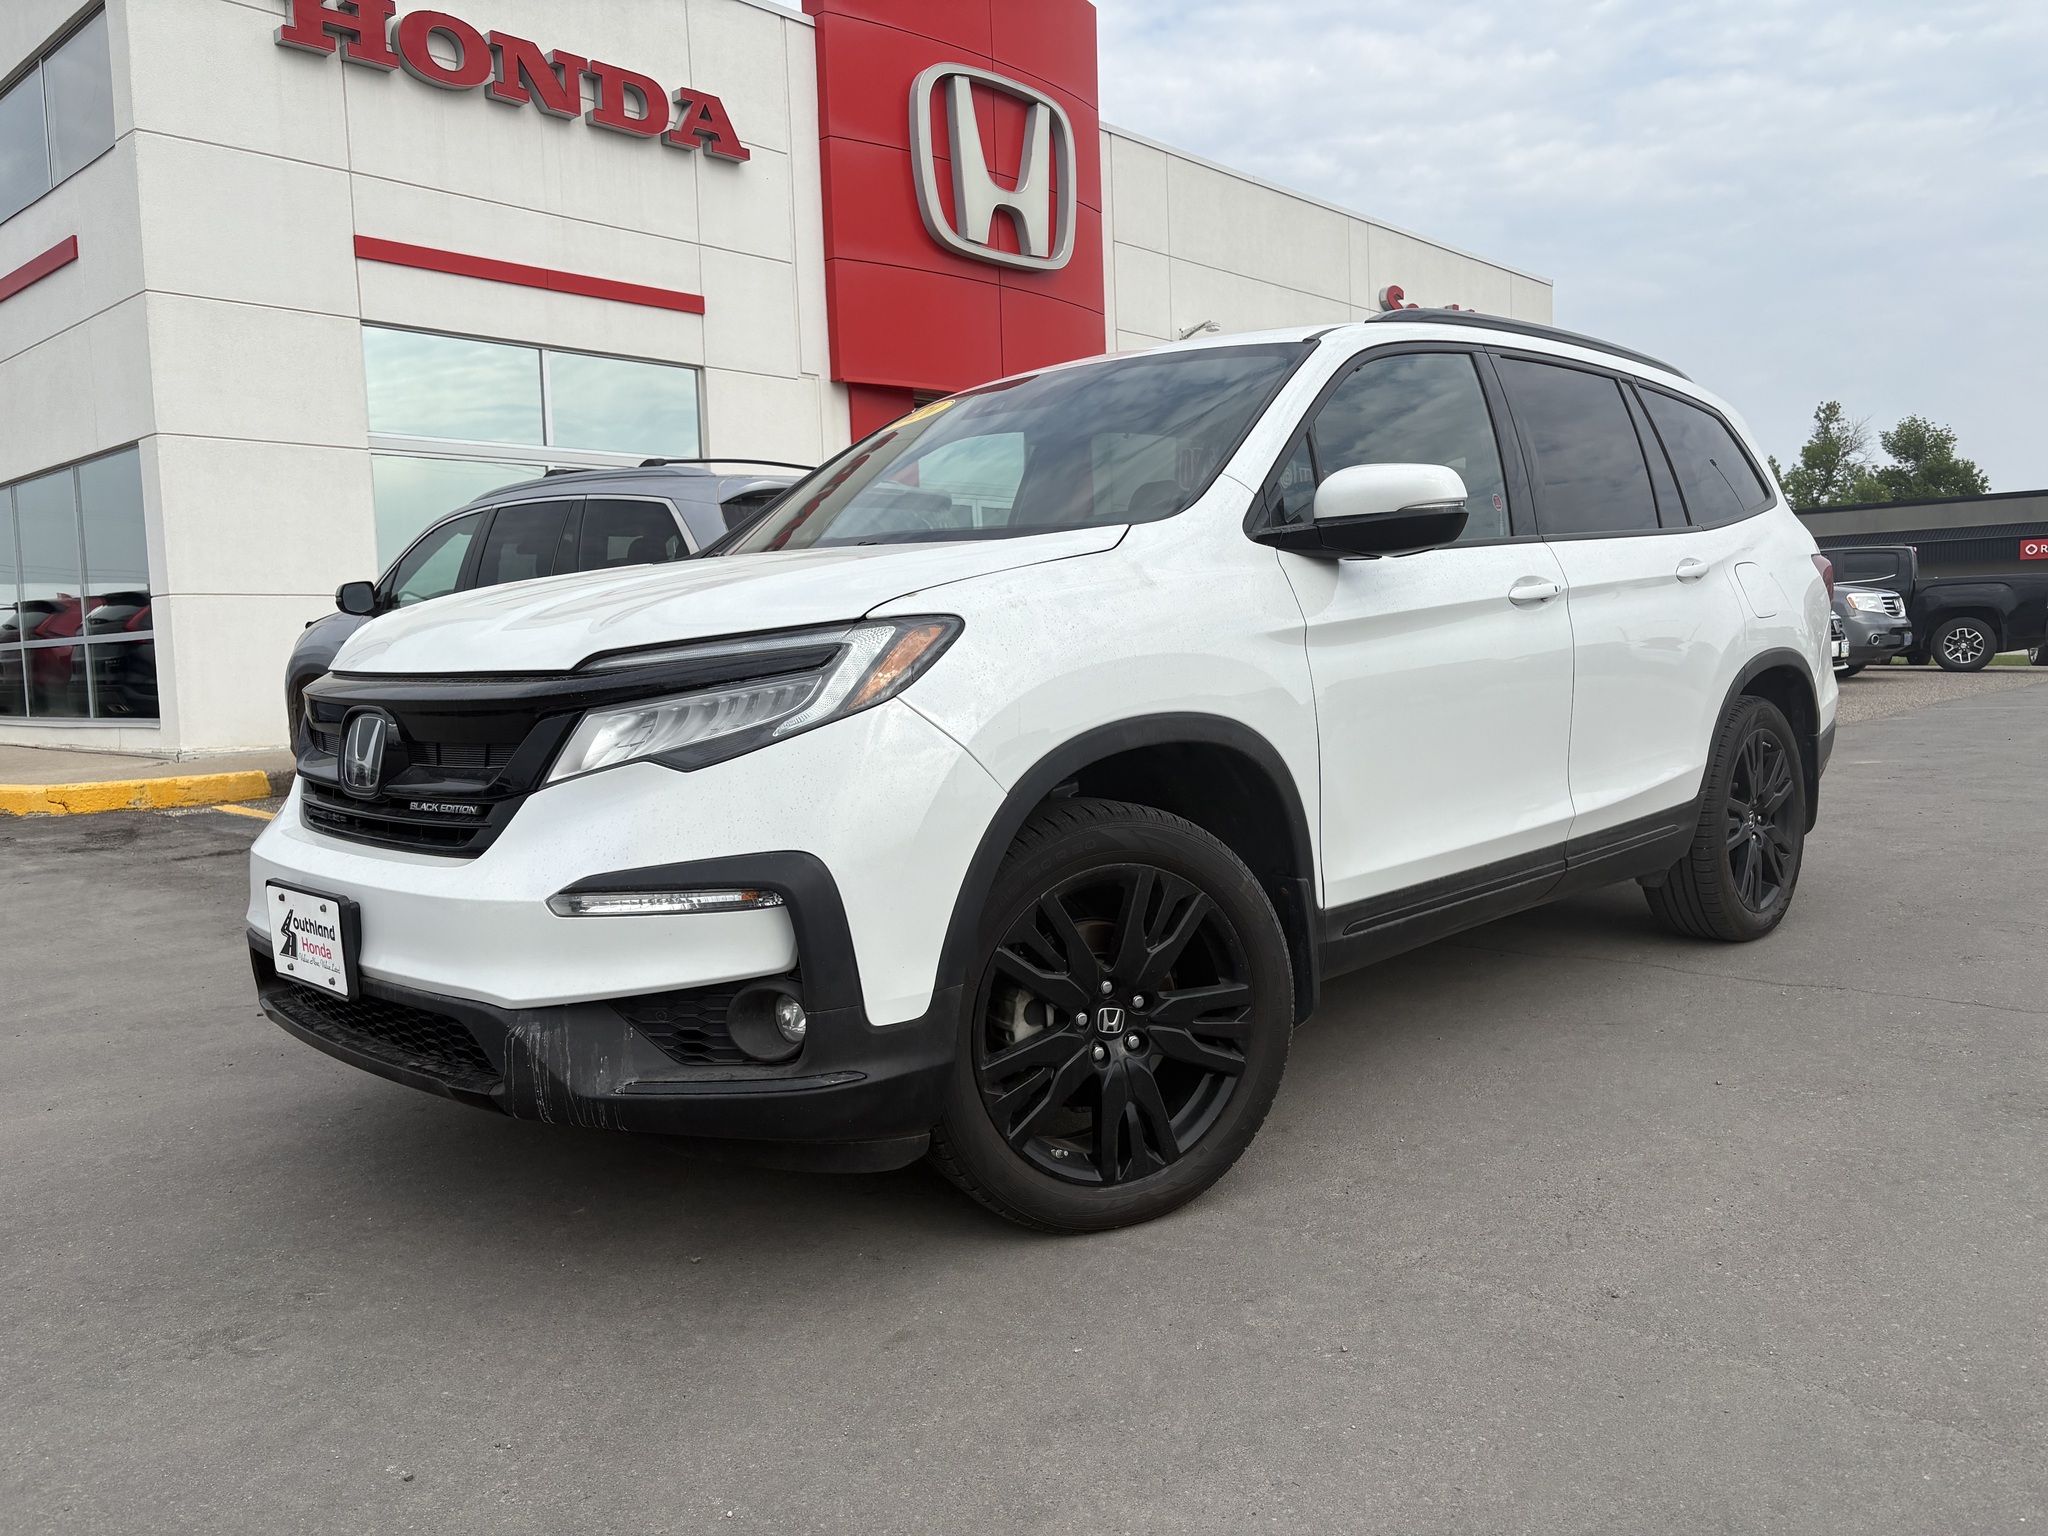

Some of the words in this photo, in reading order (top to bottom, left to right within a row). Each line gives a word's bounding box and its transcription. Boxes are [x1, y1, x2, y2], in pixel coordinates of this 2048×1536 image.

[275, 0, 750, 163] HONDA
[409, 801, 439, 812] BLACK
[439, 804, 478, 815] EDITION
[301, 936, 332, 960] Honda
